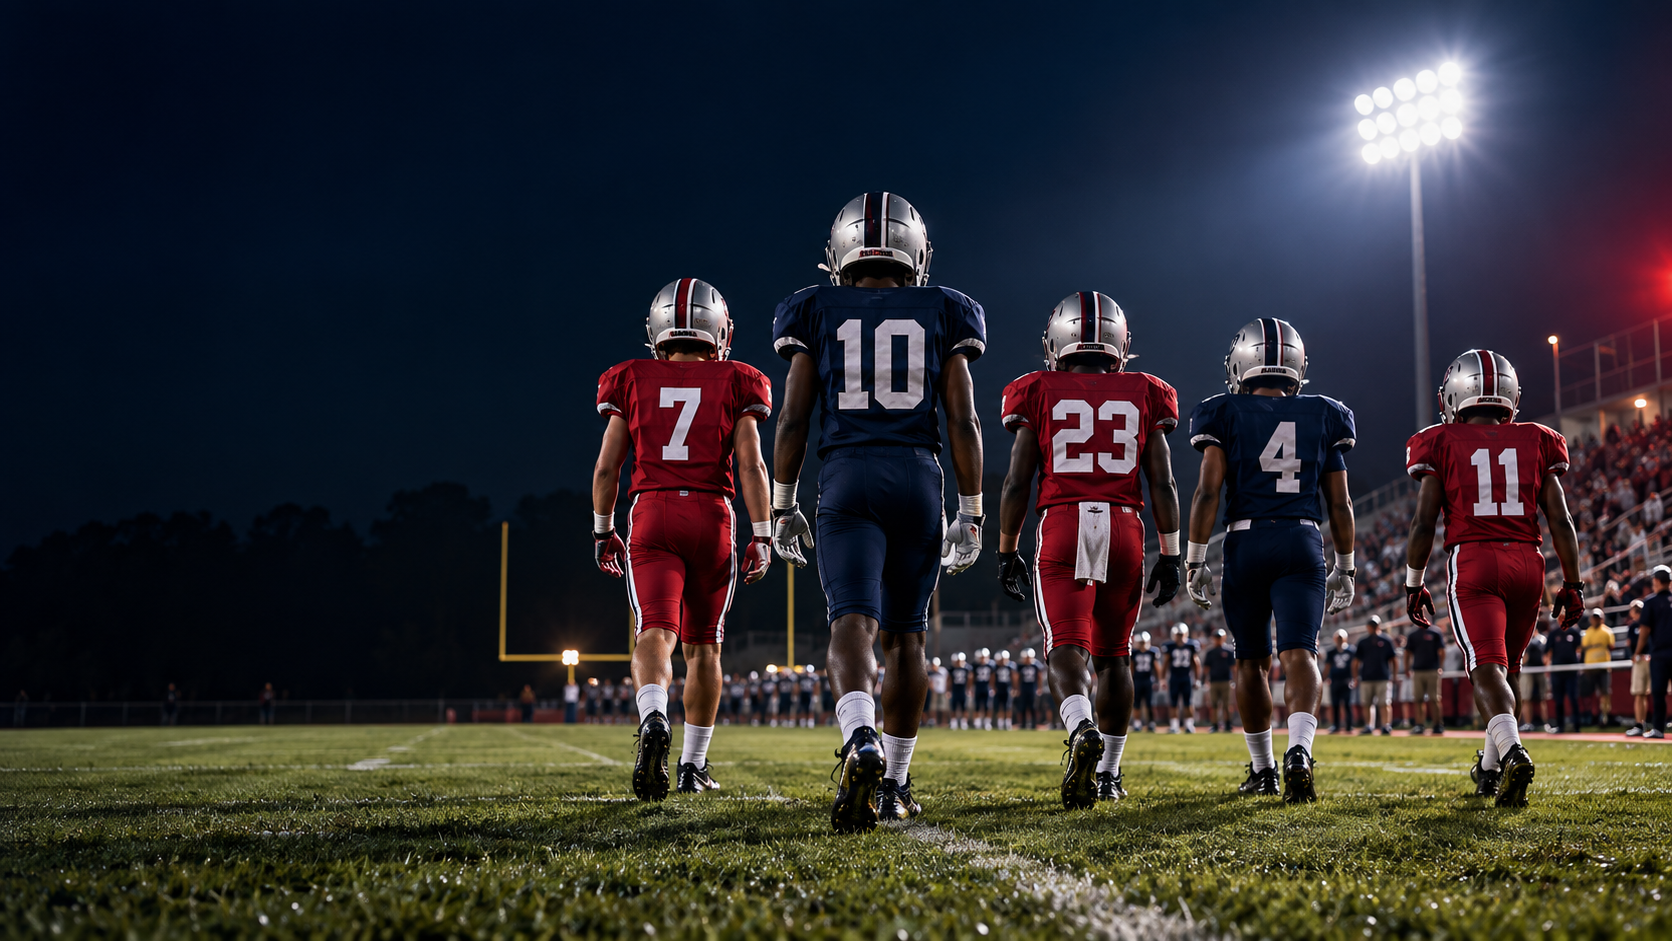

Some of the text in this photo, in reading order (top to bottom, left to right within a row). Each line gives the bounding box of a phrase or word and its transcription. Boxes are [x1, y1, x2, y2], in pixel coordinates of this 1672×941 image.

[836, 318, 926, 411] 10
[658, 386, 702, 461] 7
[1051, 399, 1140, 475] 23
[1258, 421, 1302, 494] 4
[1470, 447, 1525, 517] 11
